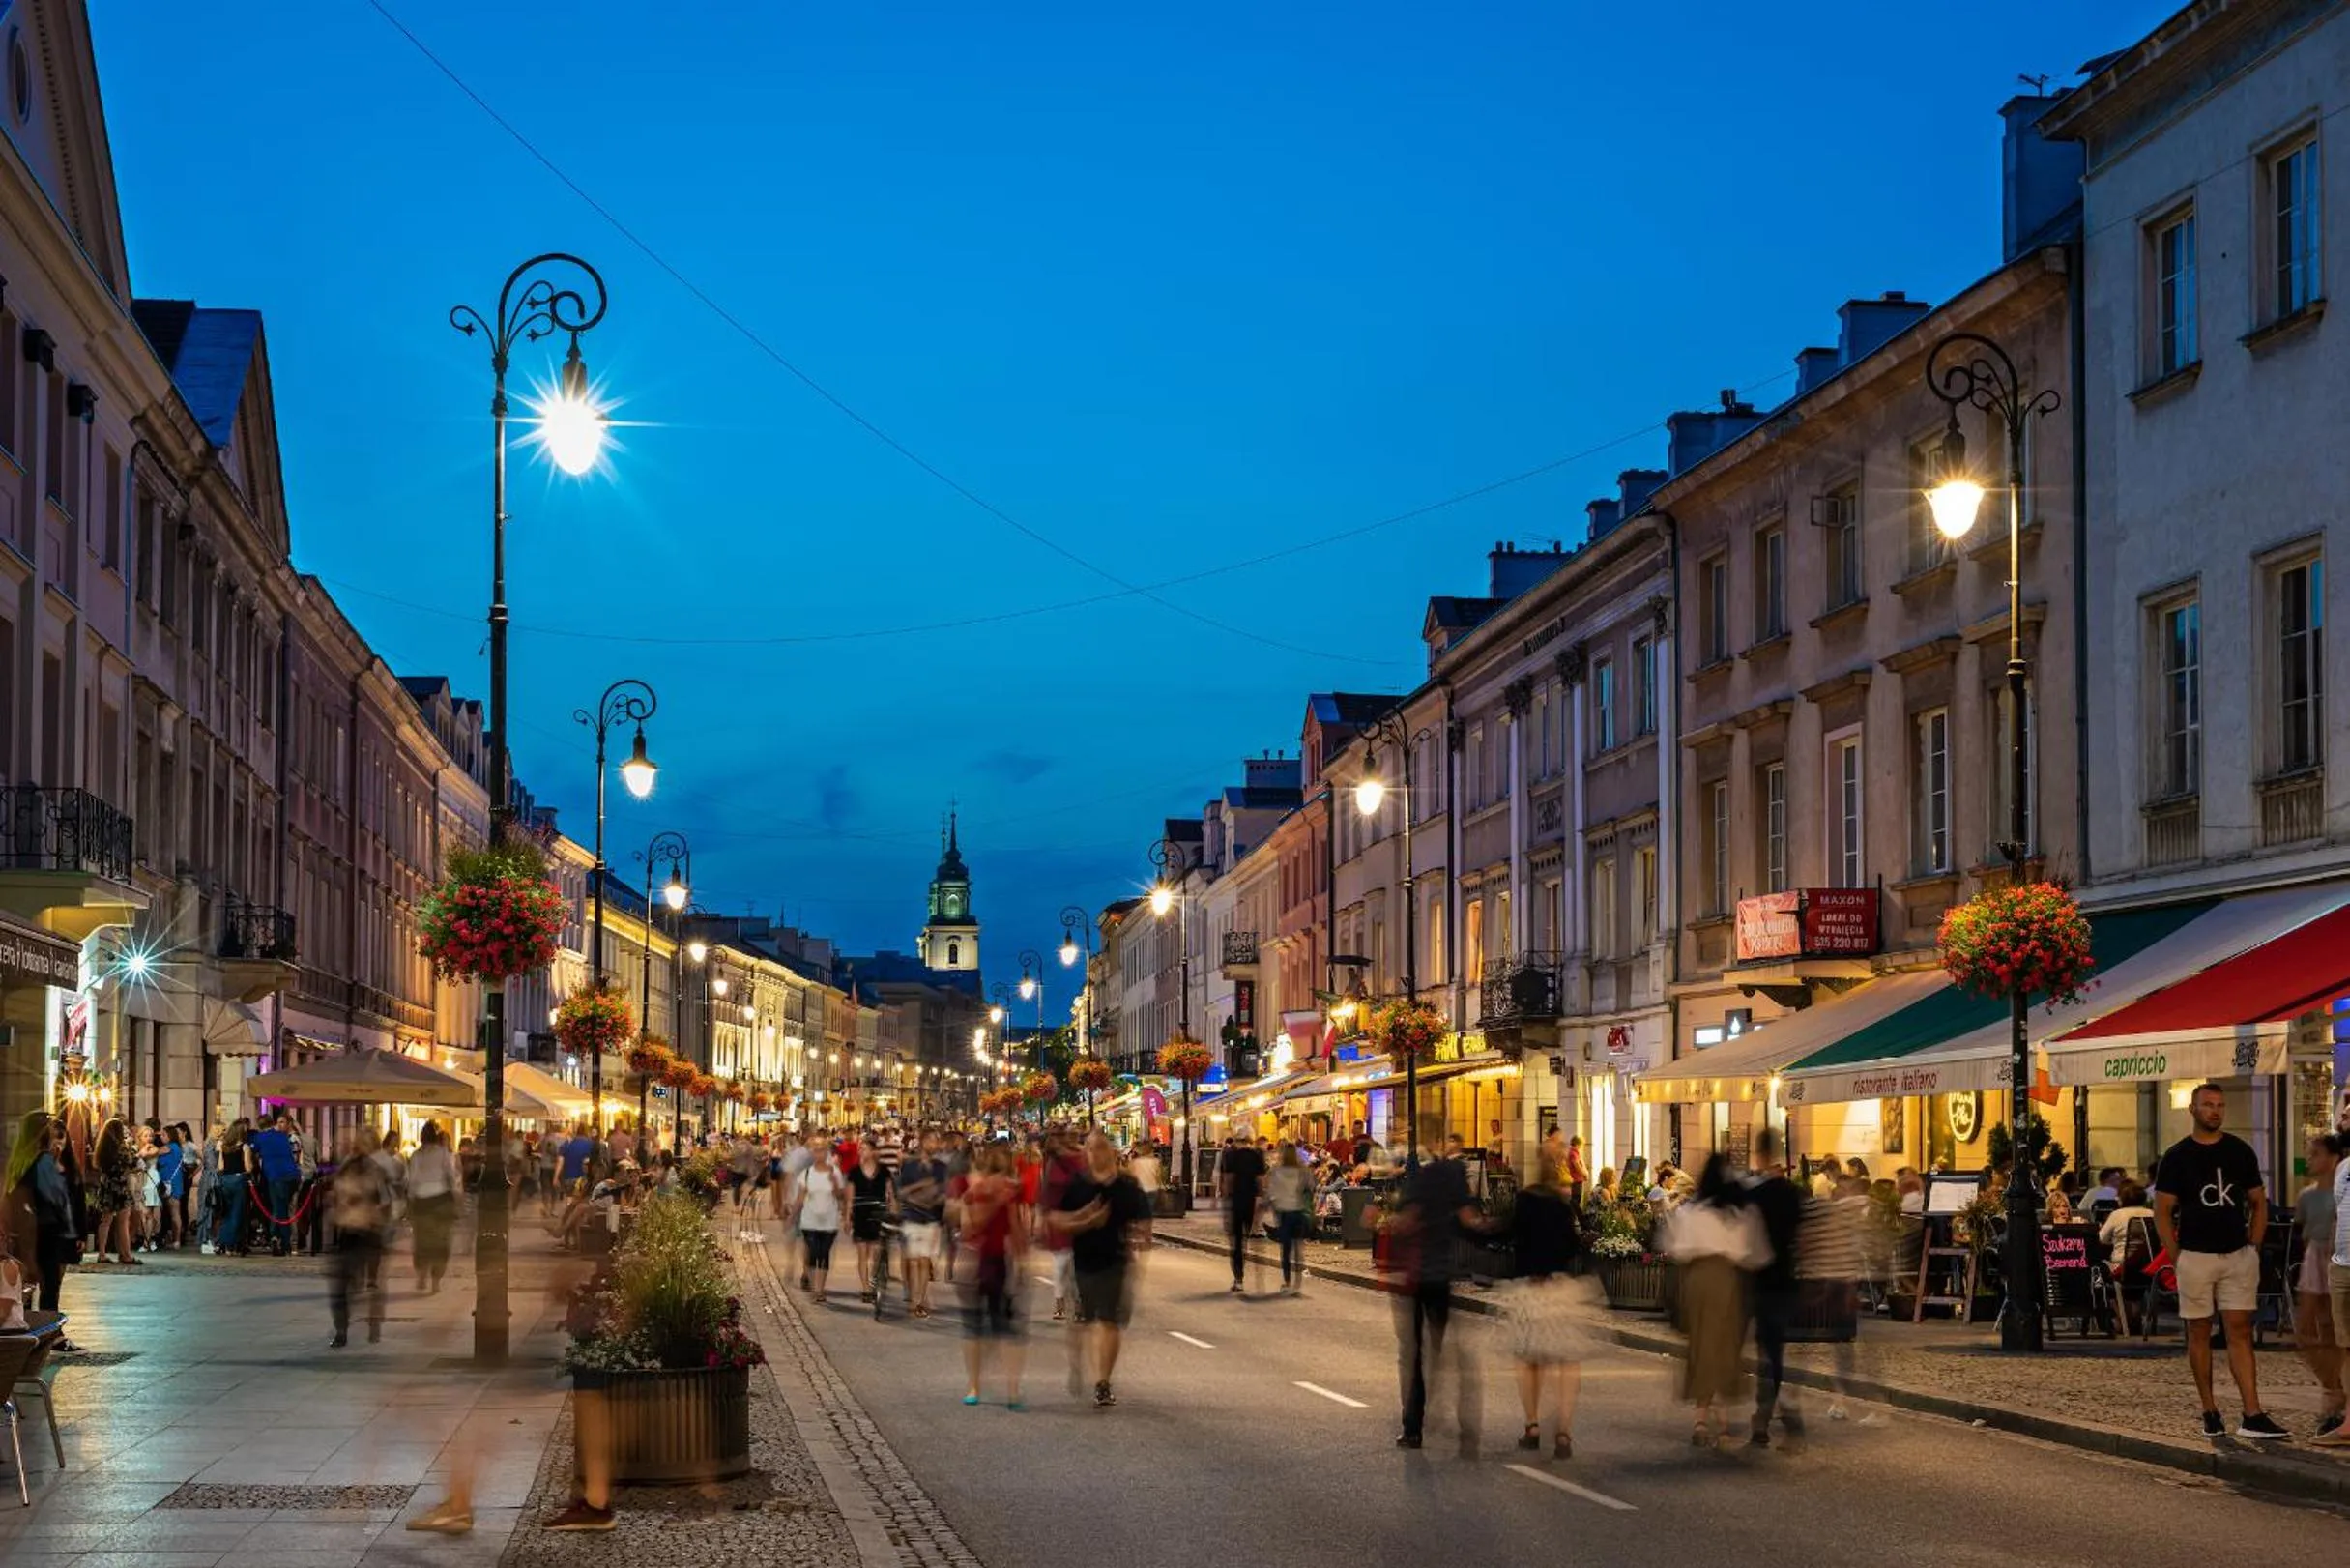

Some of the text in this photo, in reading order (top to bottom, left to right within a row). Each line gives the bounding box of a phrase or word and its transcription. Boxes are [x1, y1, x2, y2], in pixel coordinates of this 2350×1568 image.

[1819, 895, 1865, 905] MAXON
[2104, 1049, 2166, 1080] capriccio
[1853, 1068, 1937, 1094] ristorante italiano
[2200, 1168, 2235, 1207] ck
